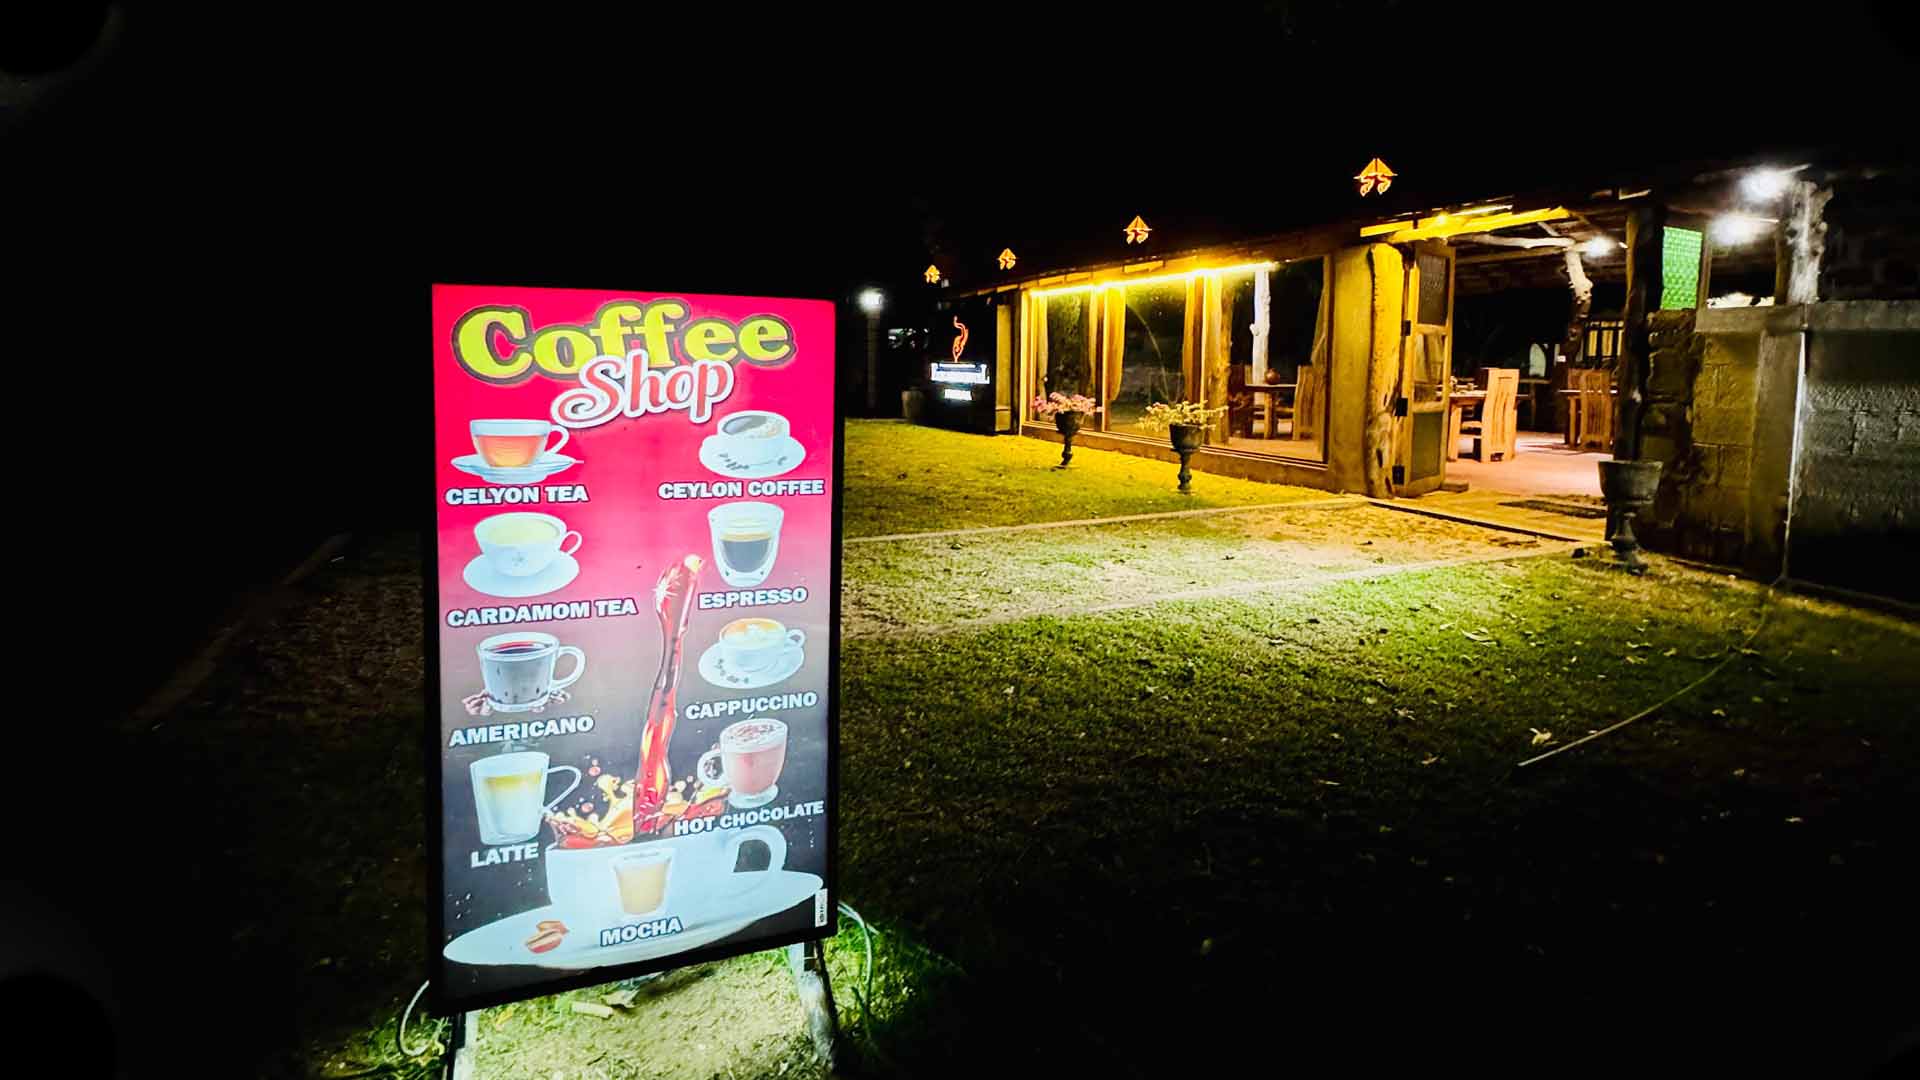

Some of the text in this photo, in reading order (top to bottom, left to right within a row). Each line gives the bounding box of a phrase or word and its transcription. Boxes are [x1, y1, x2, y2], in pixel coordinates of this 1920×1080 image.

[453, 300, 796, 383] Coffee
[551, 350, 735, 428] Shop
[446, 485, 588, 504] CELYON TEA
[658, 480, 824, 499] CEYLON COFFEE
[699, 587, 807, 609] ESPRESSO
[447, 599, 637, 627] CARDAMOM TEA
[686, 692, 817, 720] CAPPUCCINO
[449, 716, 594, 746] AMERICANO
[674, 801, 824, 836] HOT CHOCOLATE
[470, 843, 539, 867] LATTE
[600, 917, 682, 946] MOCHA
